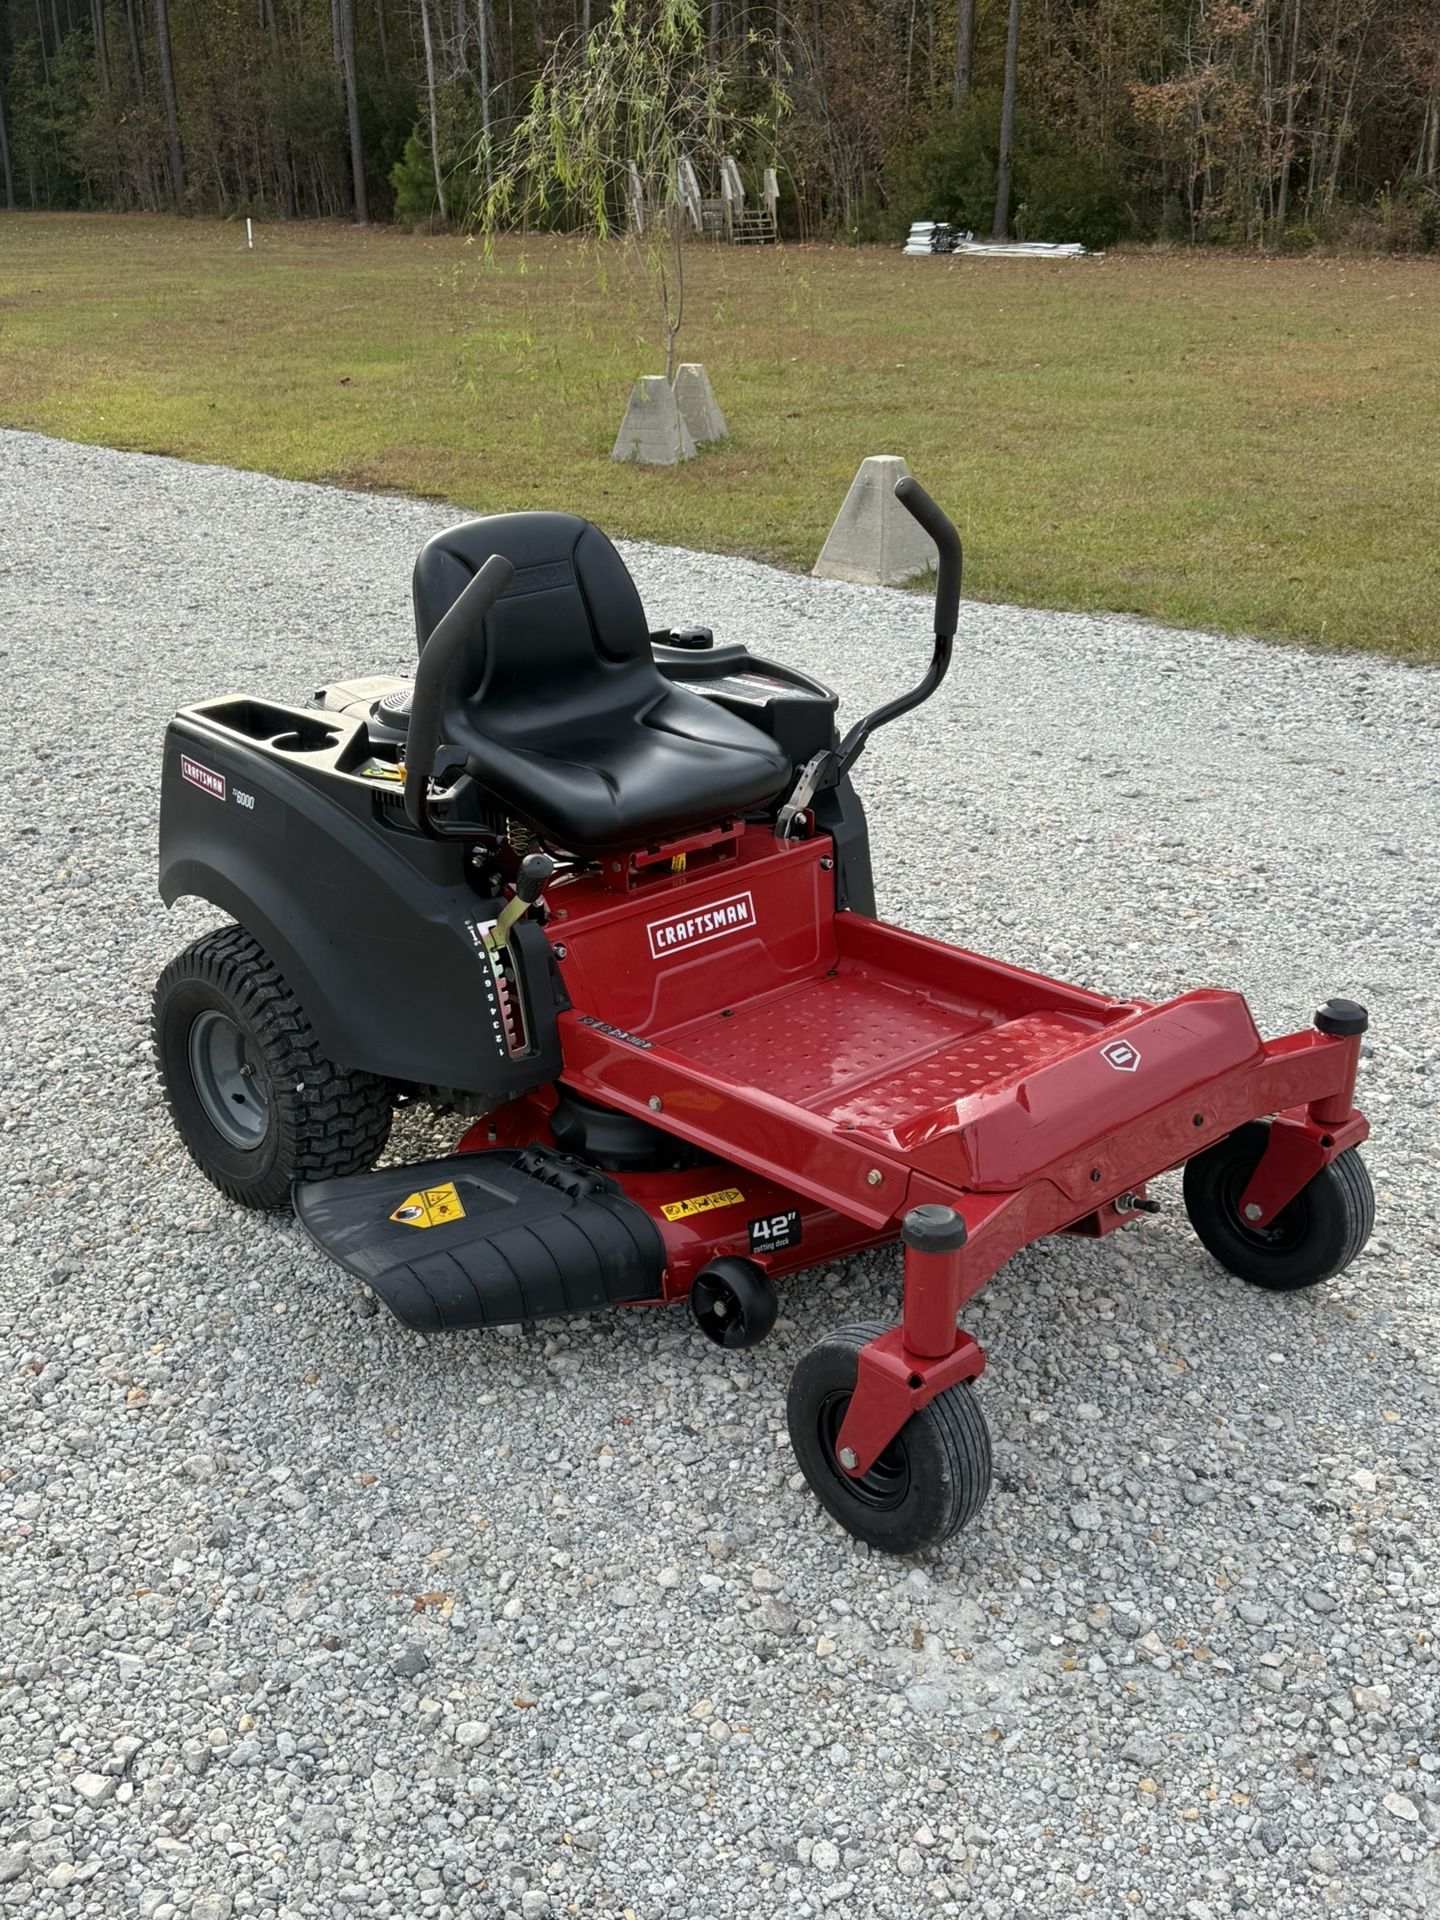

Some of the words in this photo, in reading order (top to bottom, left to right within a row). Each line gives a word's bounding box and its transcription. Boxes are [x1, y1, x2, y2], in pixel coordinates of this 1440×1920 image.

[184, 762, 222, 793] CRAFTSMAN
[656, 902, 748, 948] CRAFTSMAN
[478, 951, 486, 960] 8
[753, 1212, 796, 1239] 42"
[753, 1242, 775, 1253] cutting
[775, 1237, 789, 1247] deck
